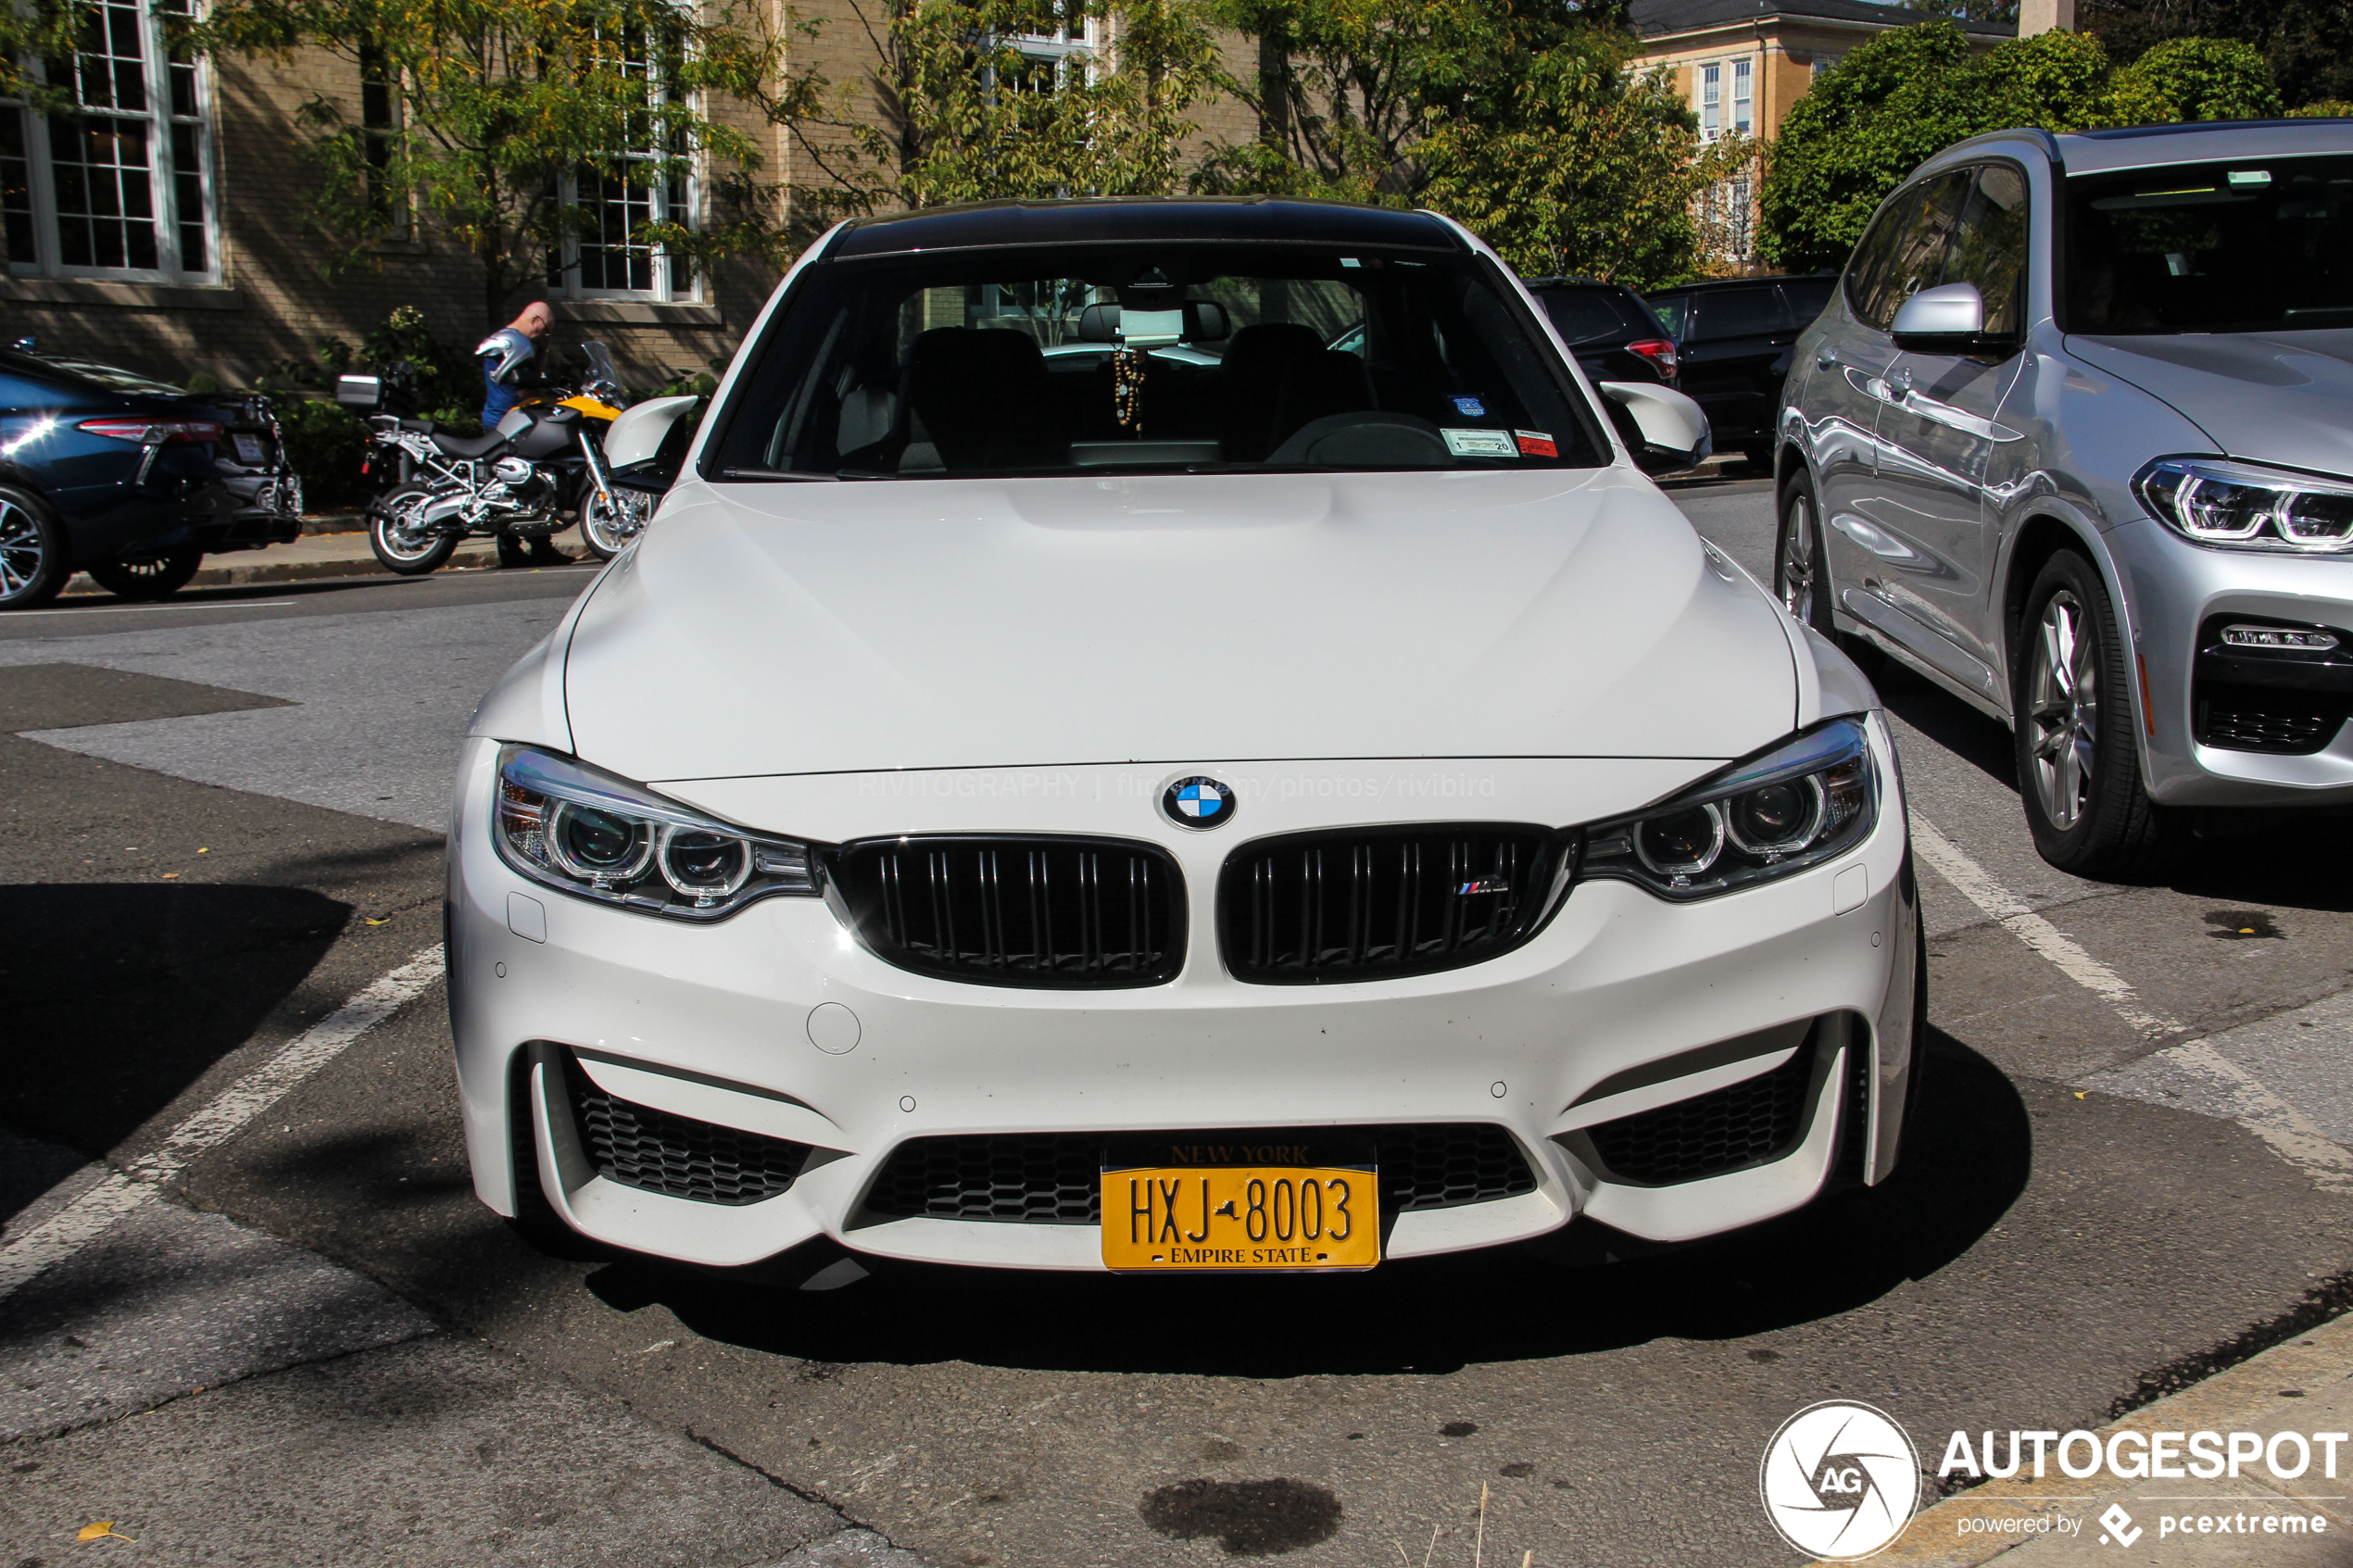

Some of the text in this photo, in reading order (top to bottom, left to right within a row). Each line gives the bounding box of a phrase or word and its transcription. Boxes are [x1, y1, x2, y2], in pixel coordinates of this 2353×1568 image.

[1169, 777, 1229, 795] BMW
[1171, 1145, 1311, 1164] NEW YORK
[1129, 1176, 1351, 1244] HXJ 8003
[1170, 1247, 1312, 1263] EMPIRE STATE
